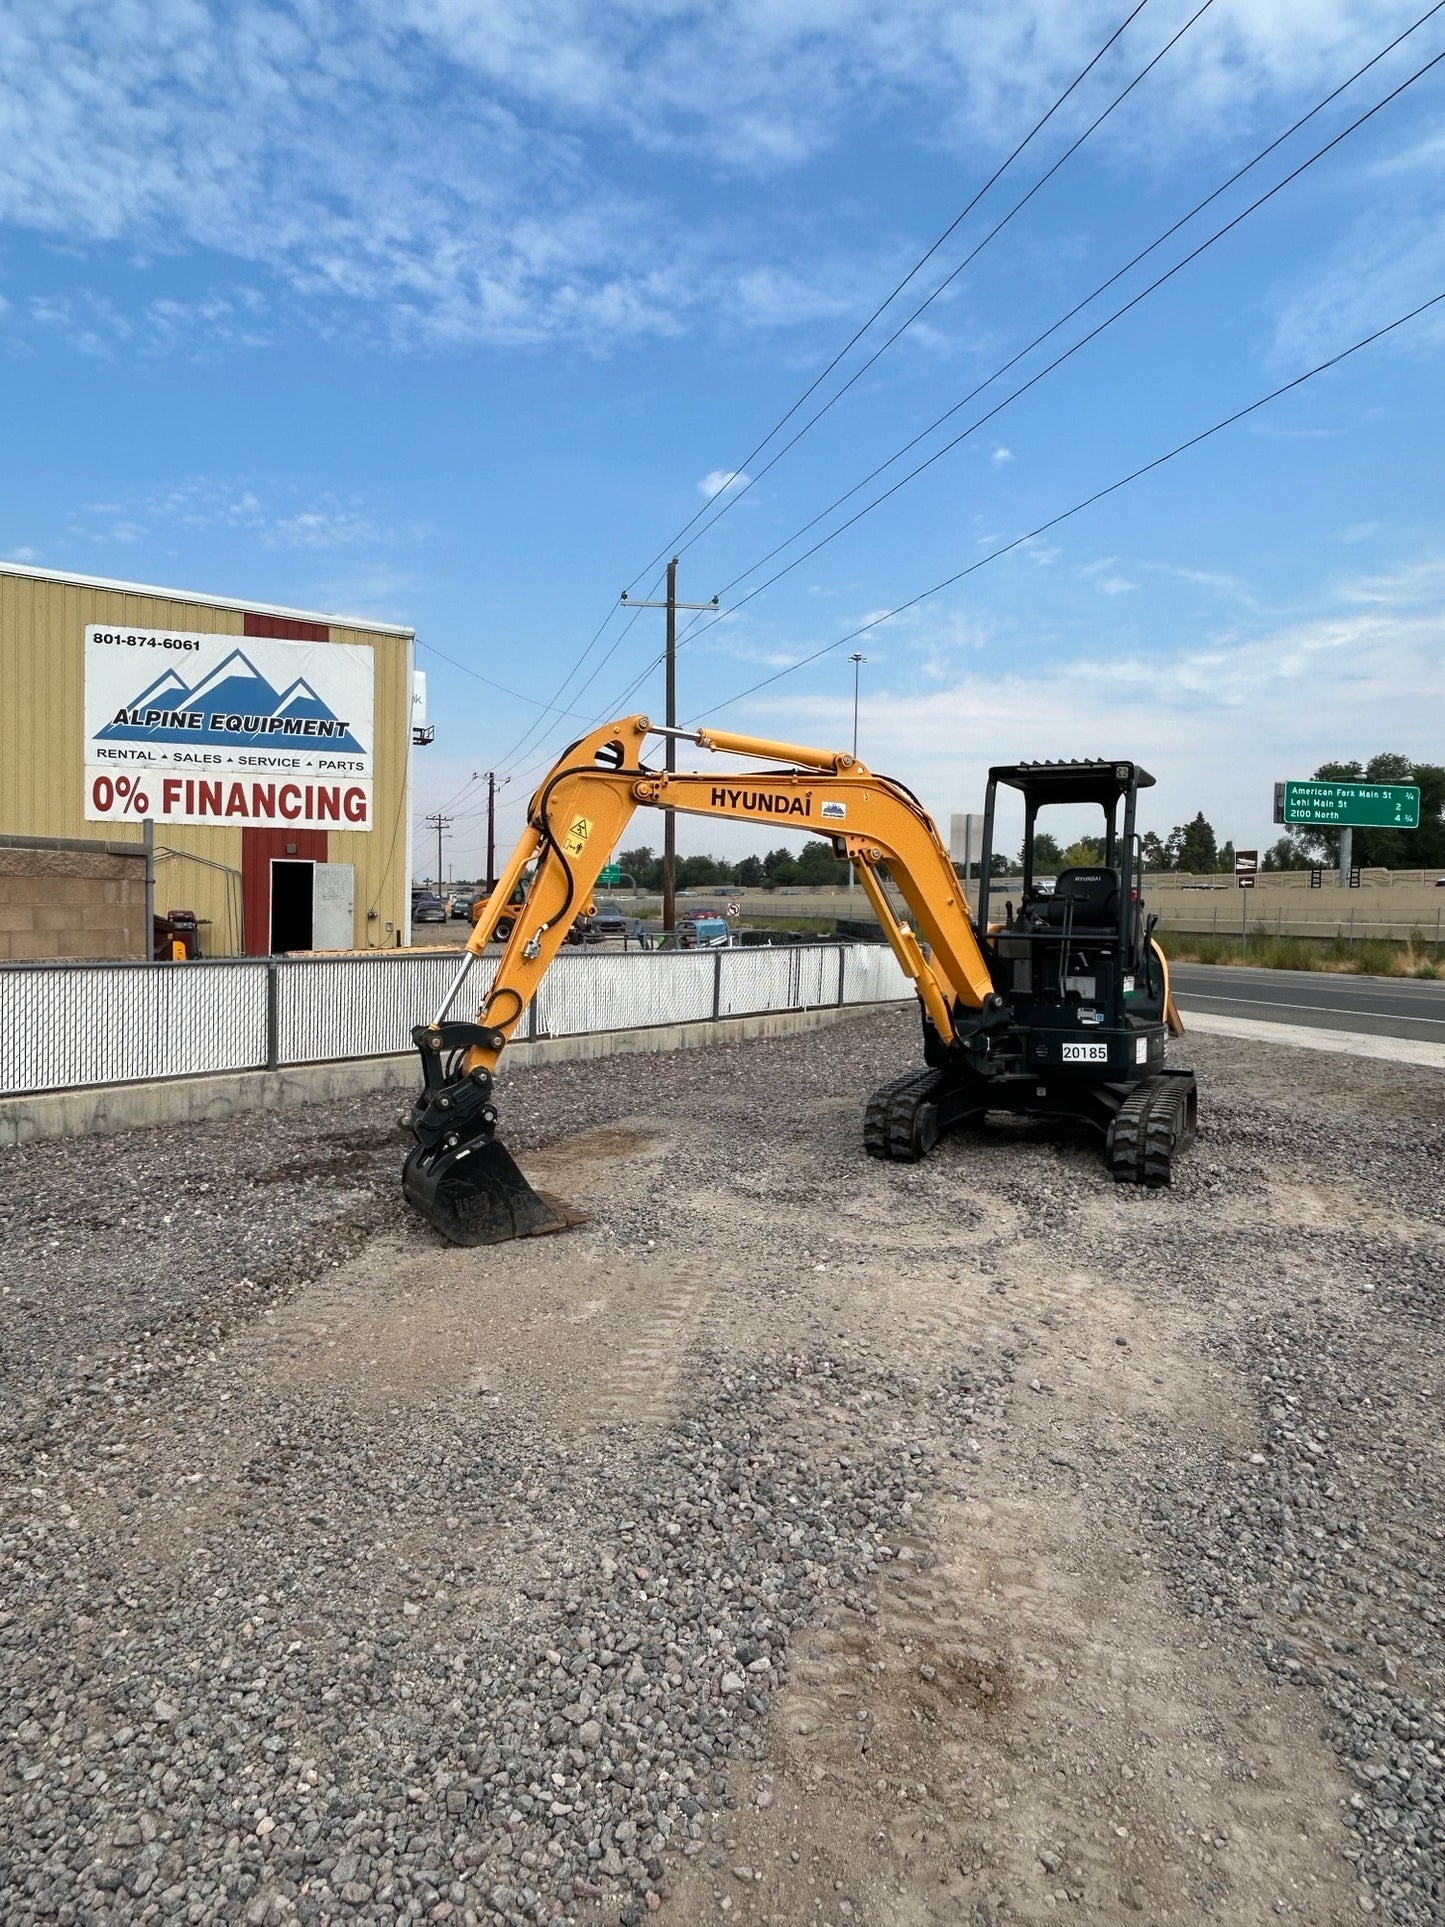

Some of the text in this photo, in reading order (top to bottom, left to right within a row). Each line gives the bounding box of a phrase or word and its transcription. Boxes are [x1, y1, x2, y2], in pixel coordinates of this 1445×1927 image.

[92, 633, 200, 651] 801-874-6061
[112, 708, 350, 738] ALPINE EQUIPMENT
[96, 748, 365, 771] RENTAL SALES SERVICE PARTS
[92, 775, 368, 822] 0% FINANCING
[711, 787, 812, 816] HYUNDAI
[1292, 787, 1333, 796] American
[1336, 788, 1356, 798] Fork
[1359, 789, 1379, 799] Main
[1382, 791, 1392, 799] St
[1290, 798, 1310, 807] Lehi
[1313, 799, 1334, 808] Main
[1338, 800, 1348, 808] St
[1290, 809, 1312, 818] 2100
[1314, 810, 1339, 819] North
[1063, 1046, 1106, 1059] 20185
